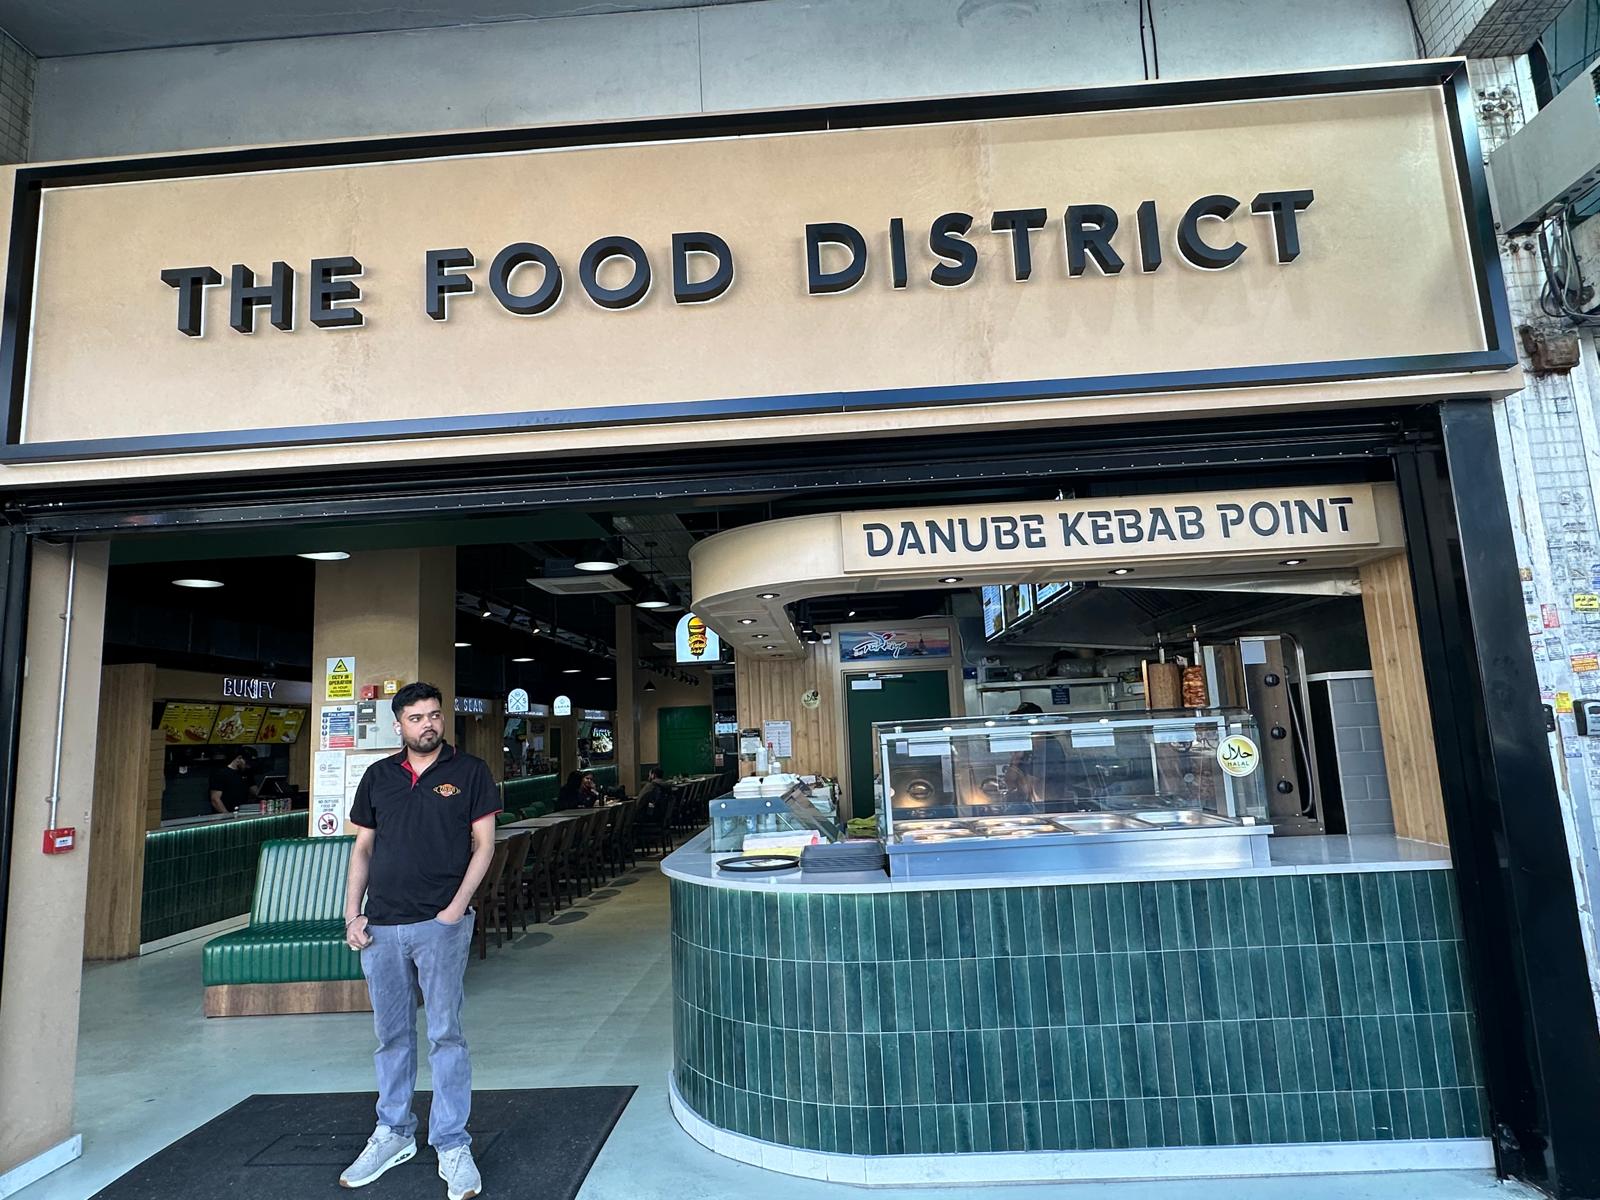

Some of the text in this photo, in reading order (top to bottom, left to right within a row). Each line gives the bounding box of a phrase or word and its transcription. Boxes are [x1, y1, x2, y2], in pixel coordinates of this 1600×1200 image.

[161, 189, 1315, 337] THE FOOD DISTRICT
[862, 496, 1353, 557] DANUBE KEBAB POINT
[463, 698, 483, 712] SEAR
[1222, 743, 1252, 760] حلال
